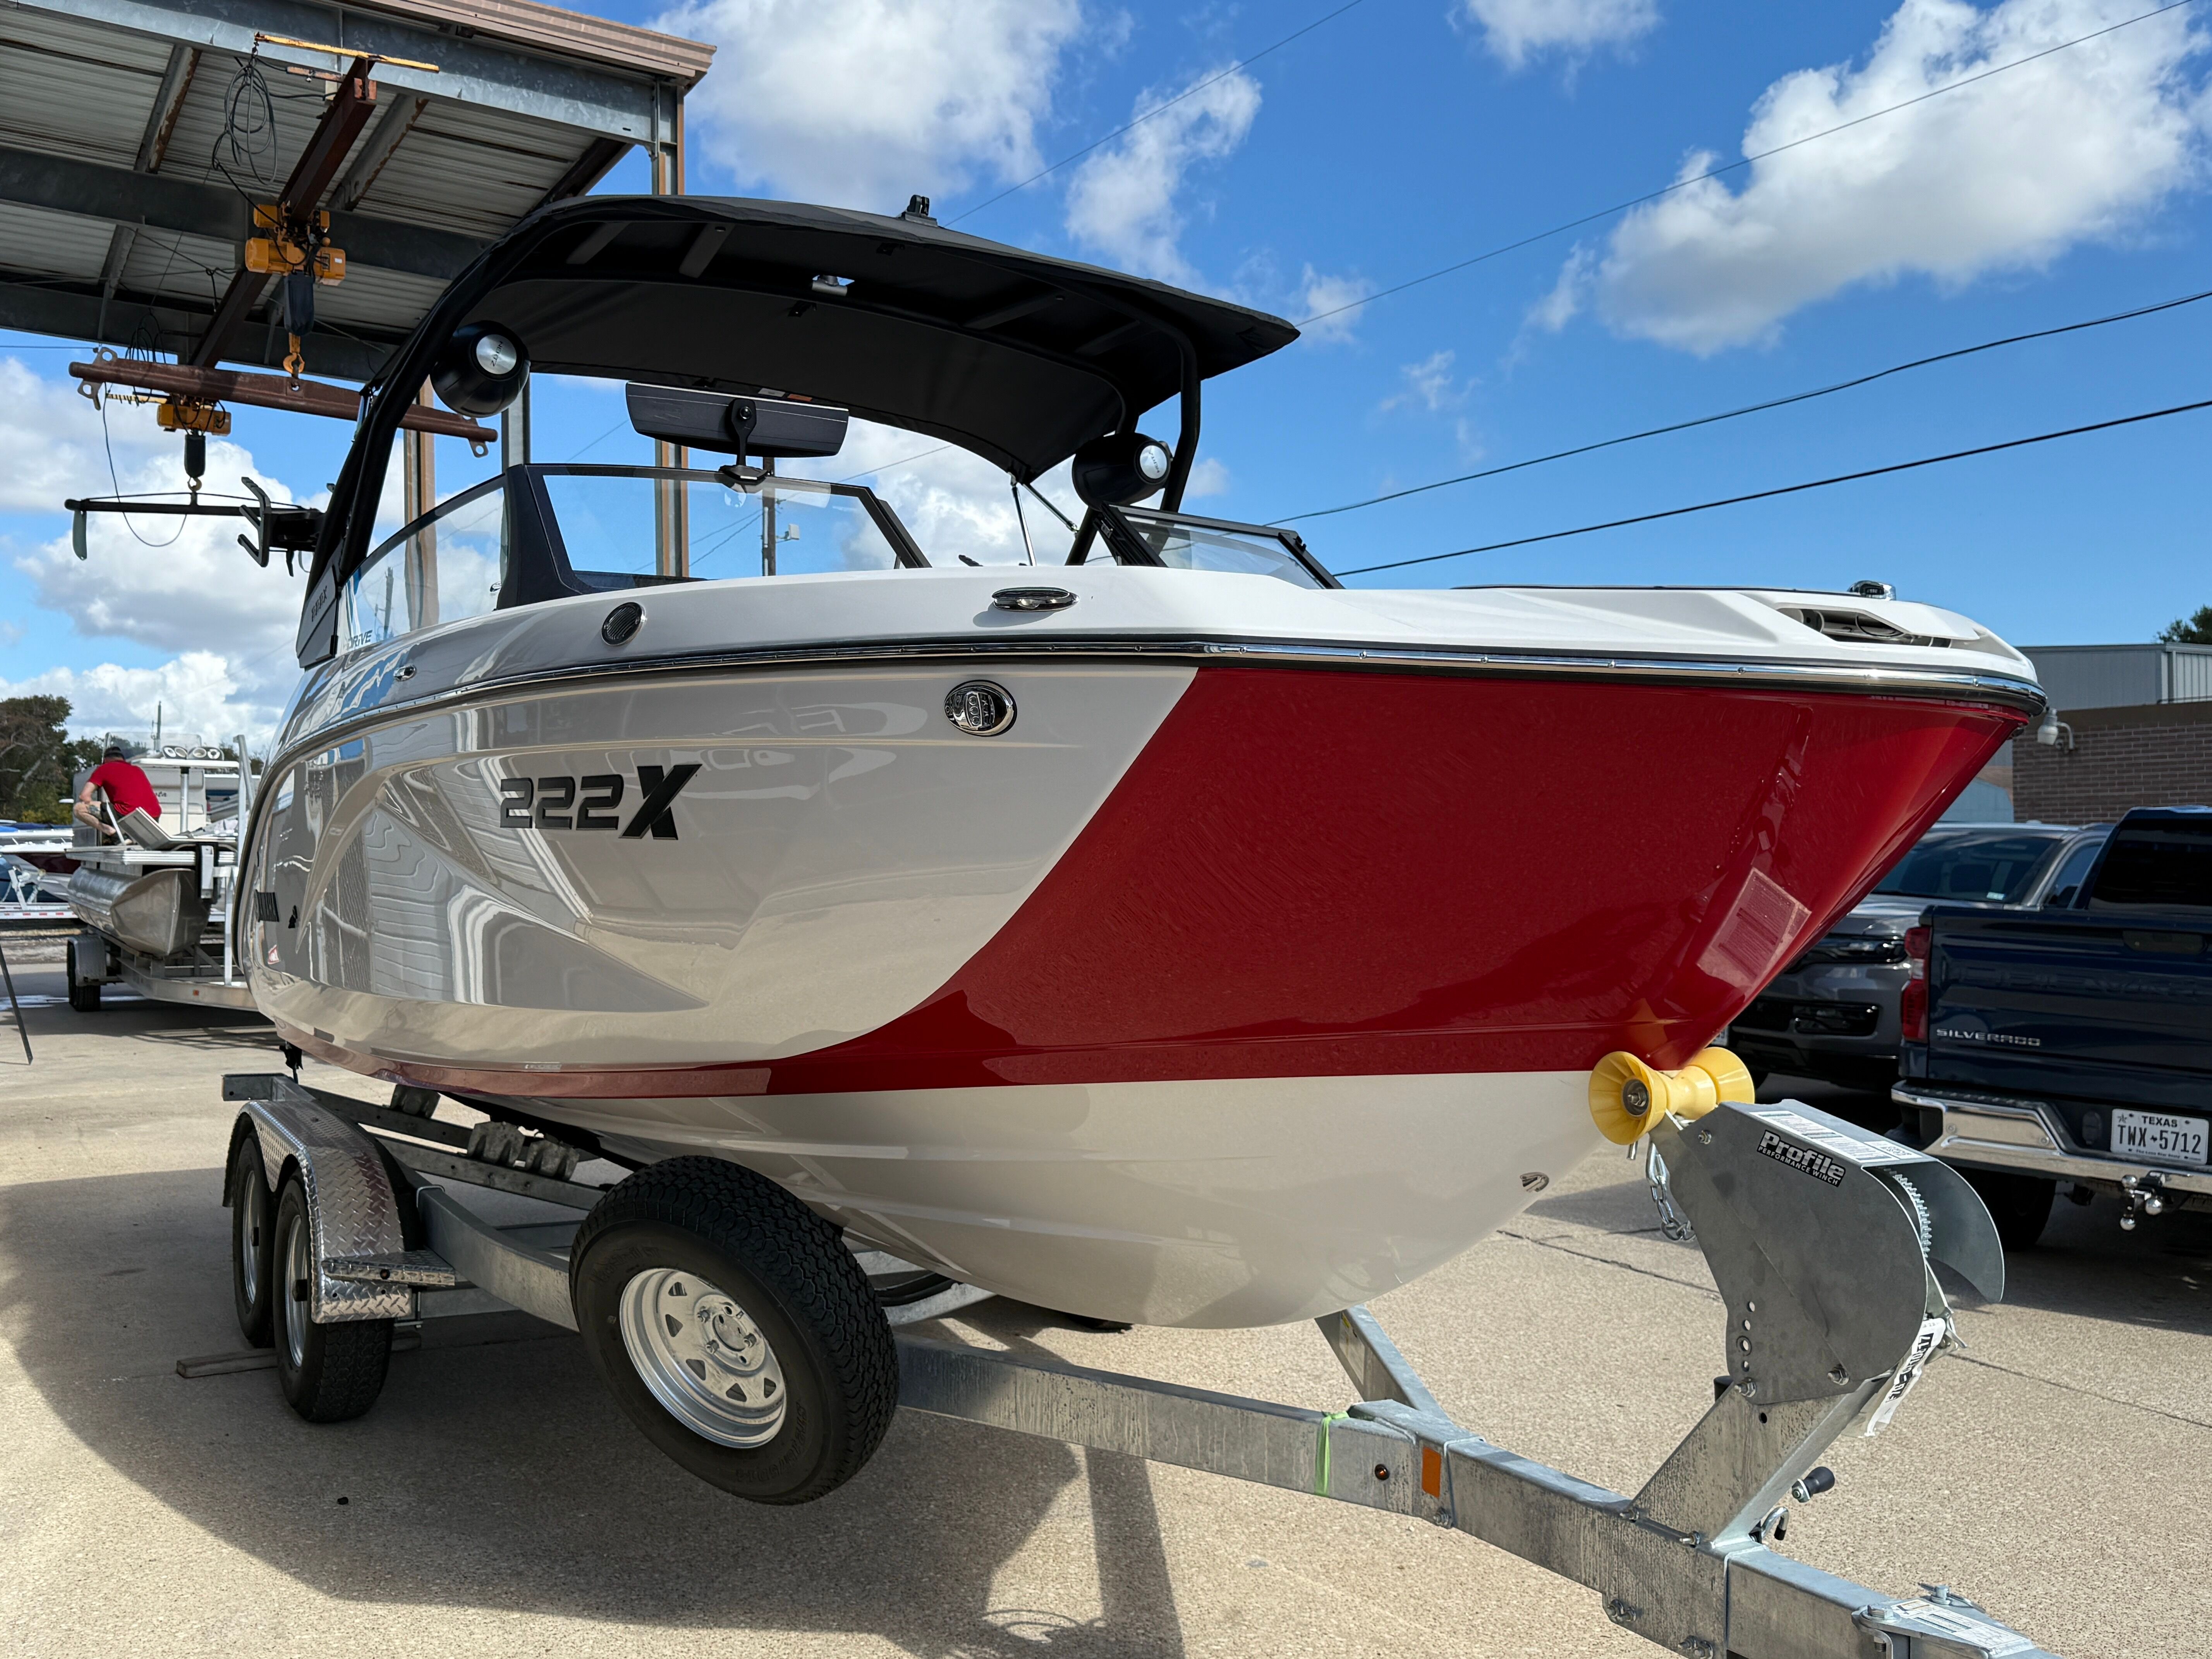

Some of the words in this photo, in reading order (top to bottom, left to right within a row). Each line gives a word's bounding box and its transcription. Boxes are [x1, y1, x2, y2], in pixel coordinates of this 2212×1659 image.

[500, 764, 702, 840] 222X
[1937, 1029, 2040, 1046] SILVERADO
[2142, 1115, 2178, 1127] TEXAS
[1760, 1131, 1845, 1181] Profile
[2118, 1125, 2147, 1147] TWX
[2159, 1130, 2201, 1154] 5712
[1758, 1146, 1811, 1173] PERFORMANCE
[1812, 1170, 1838, 1185] WINCH
